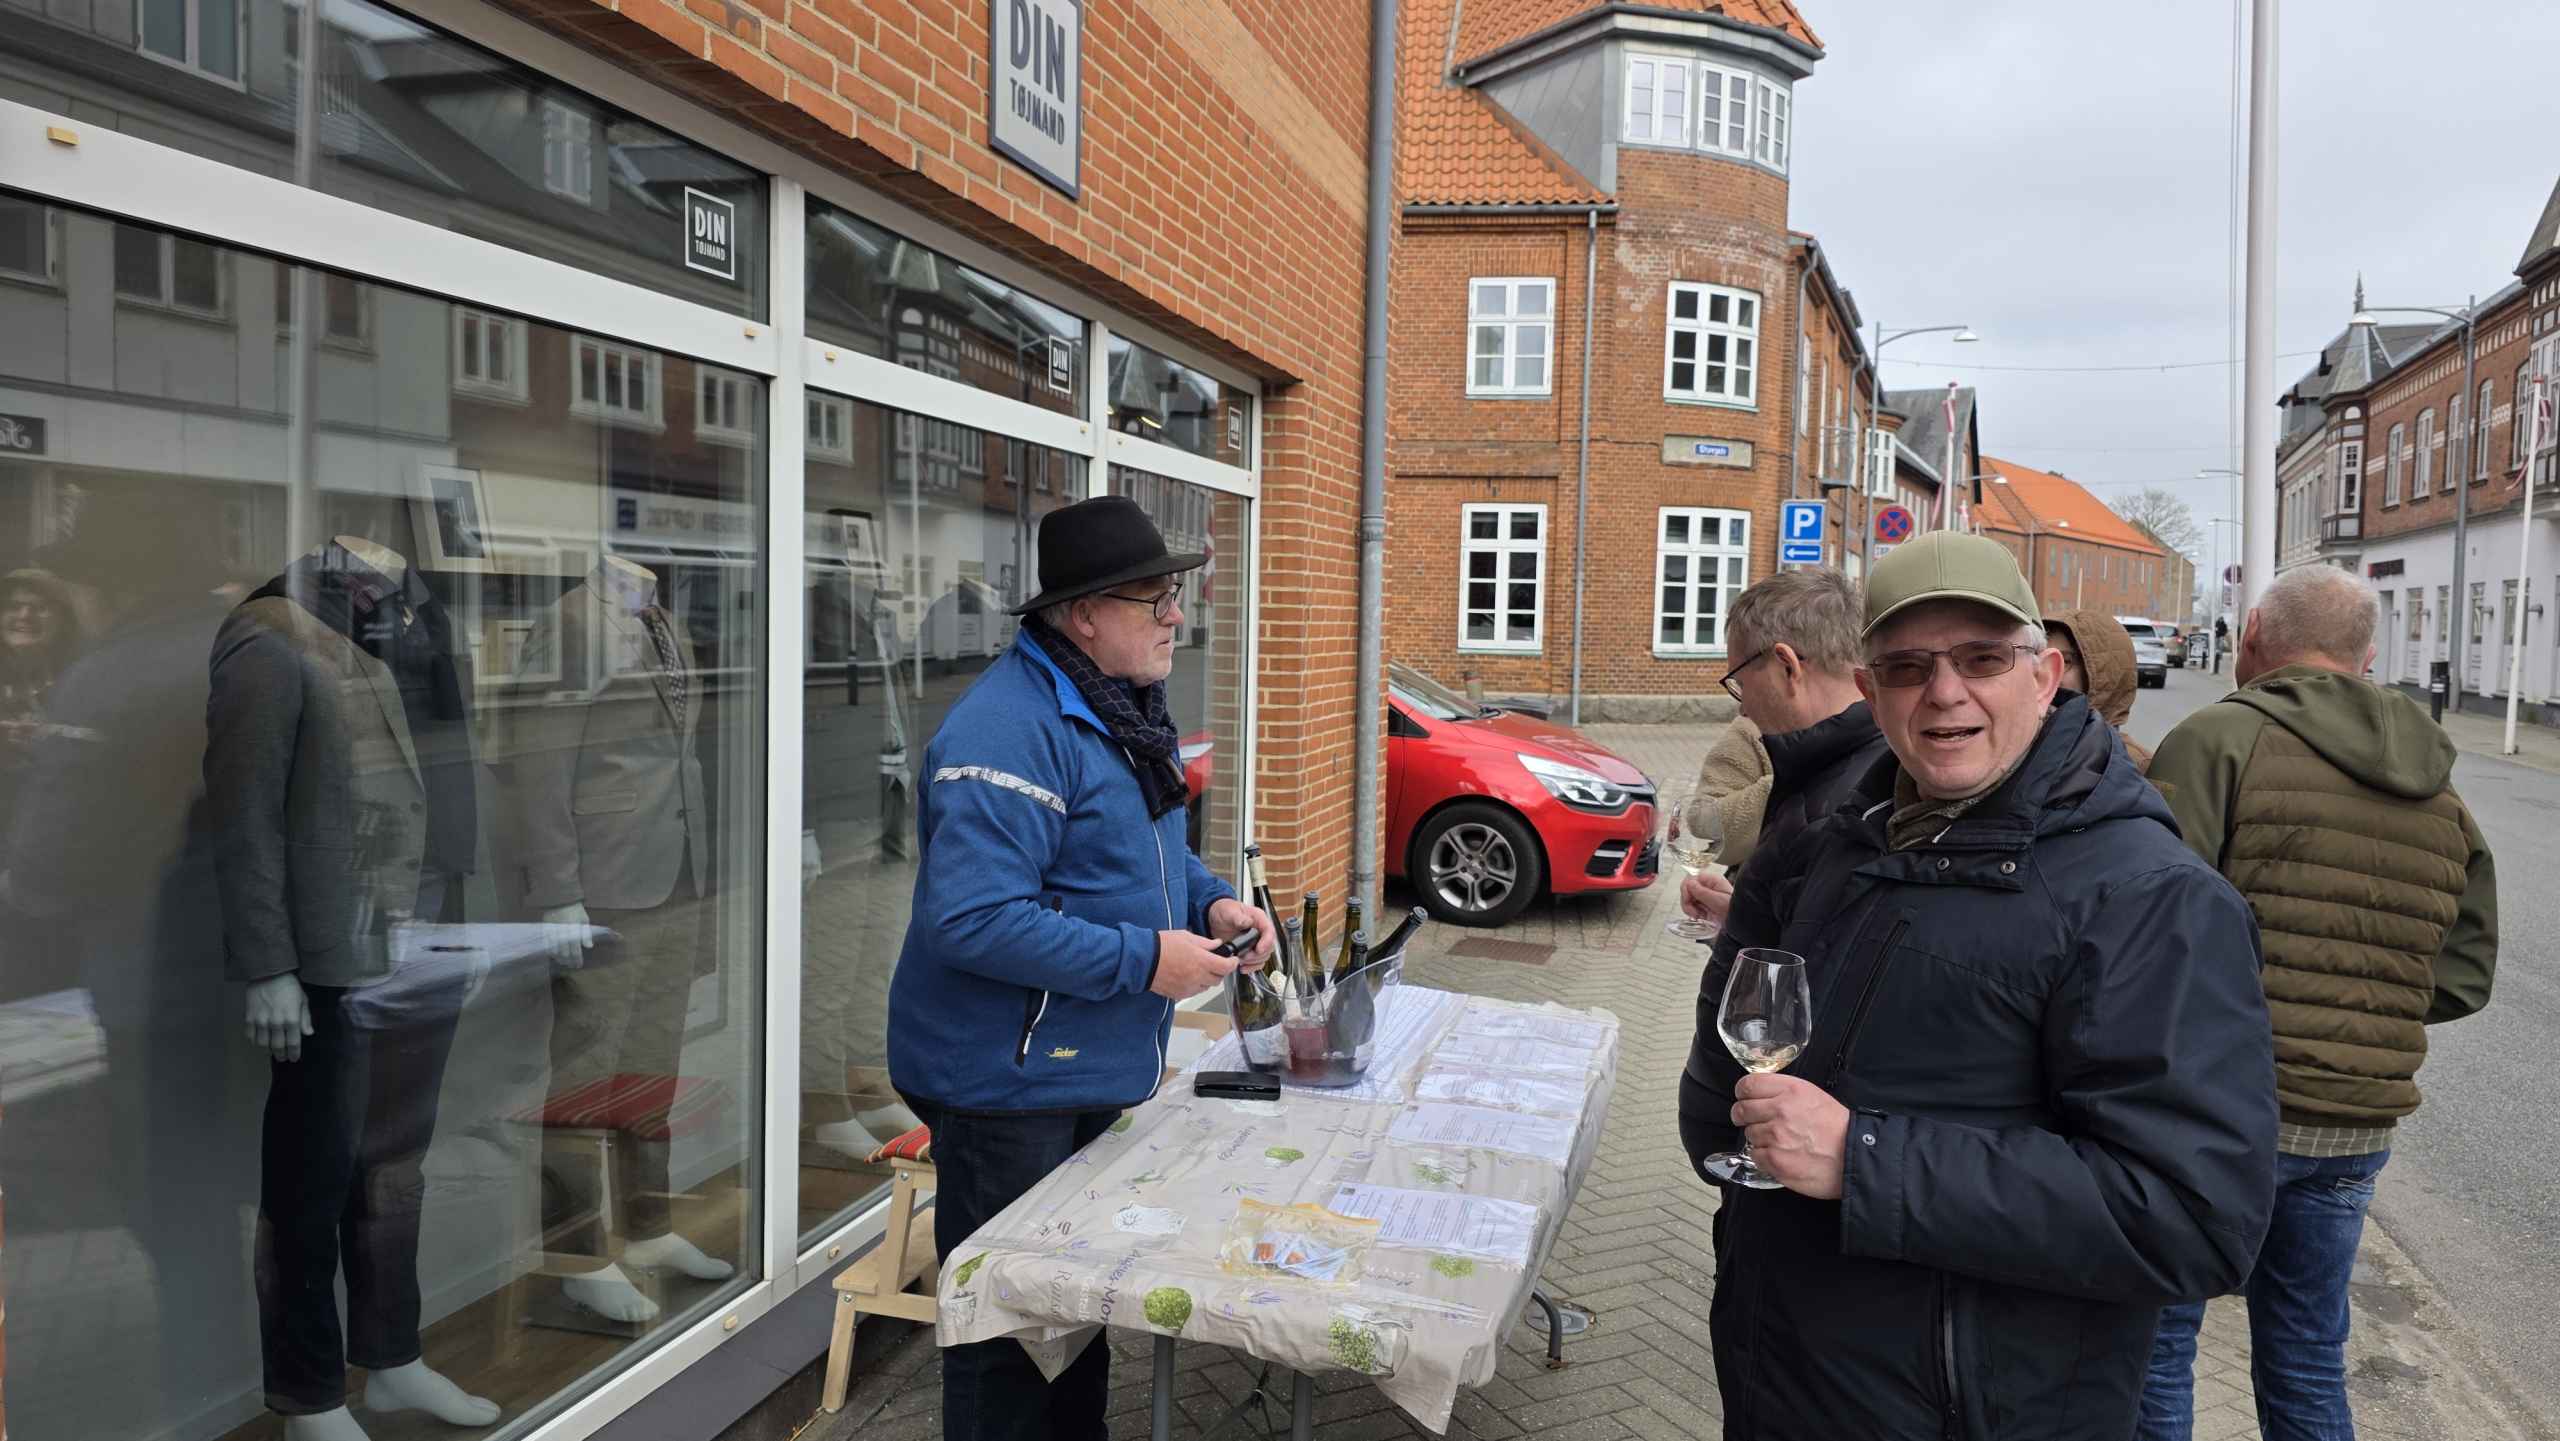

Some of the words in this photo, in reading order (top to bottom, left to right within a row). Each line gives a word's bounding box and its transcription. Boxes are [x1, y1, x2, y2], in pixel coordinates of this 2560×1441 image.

[1010, 0, 1066, 103] DIN
[1009, 78, 1066, 146] TØJMAND
[694, 205, 726, 245] DIN
[1053, 347, 1068, 371] DIN
[1793, 508, 1816, 537] P
